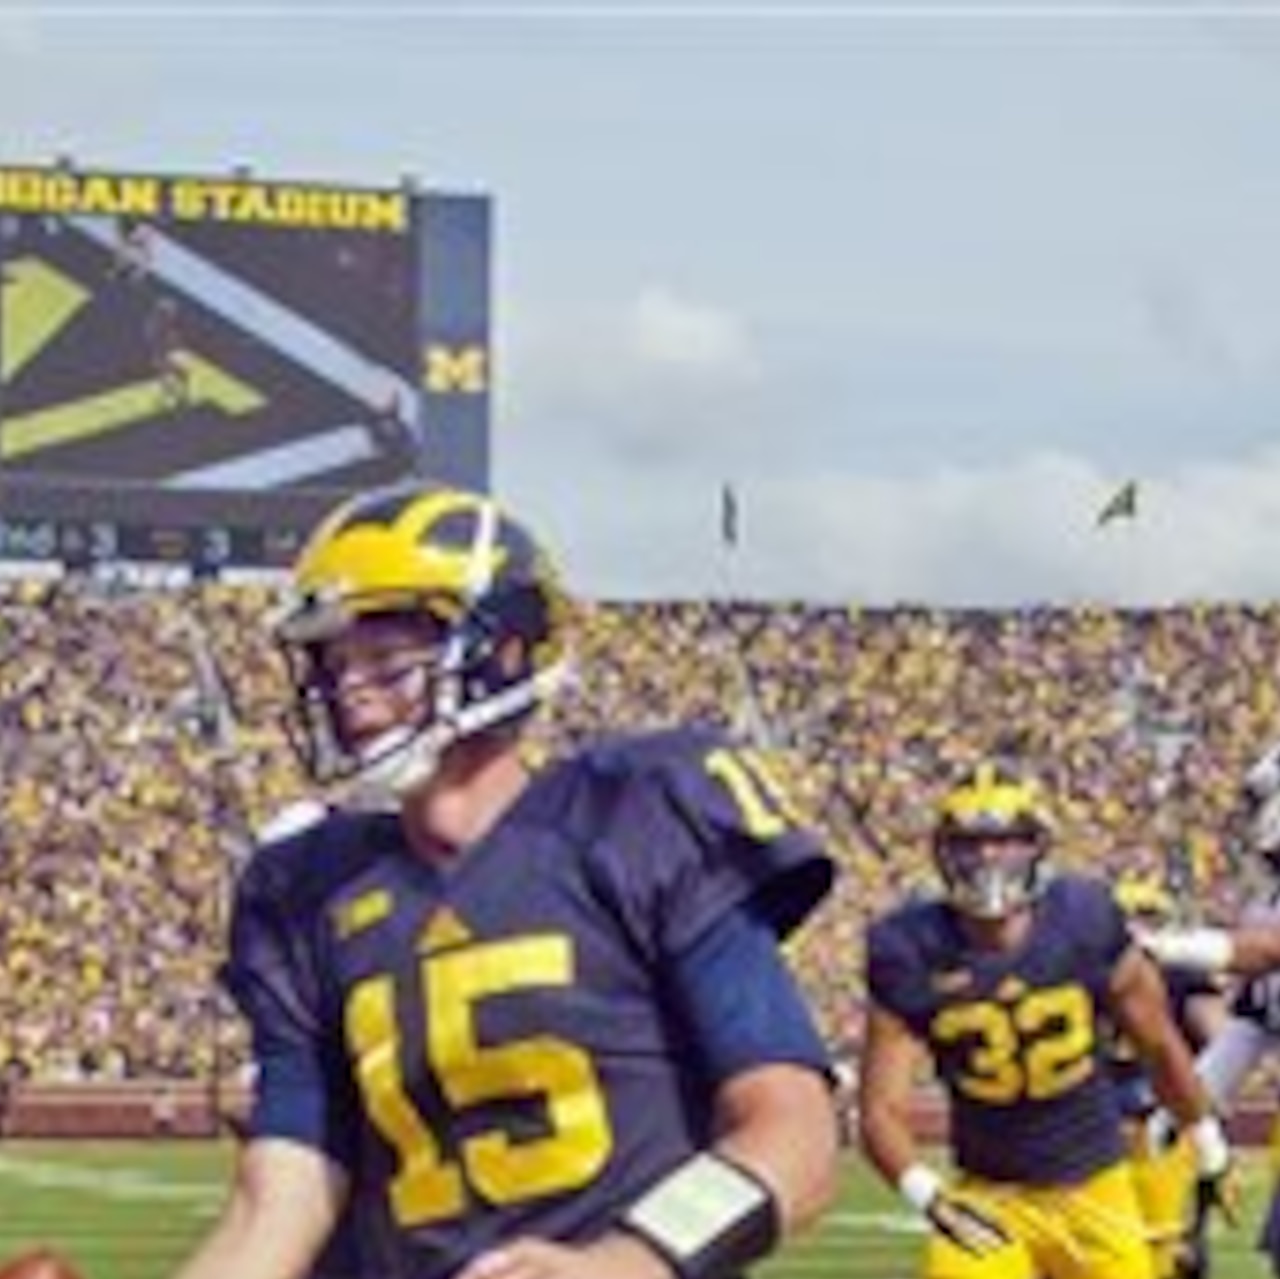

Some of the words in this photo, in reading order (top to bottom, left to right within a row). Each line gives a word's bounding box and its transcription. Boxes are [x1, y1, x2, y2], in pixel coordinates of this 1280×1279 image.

[173, 177, 407, 232] STADIUM
[426, 346, 485, 392] M
[344, 934, 613, 1228] 15
[931, 984, 1094, 1106] 32
